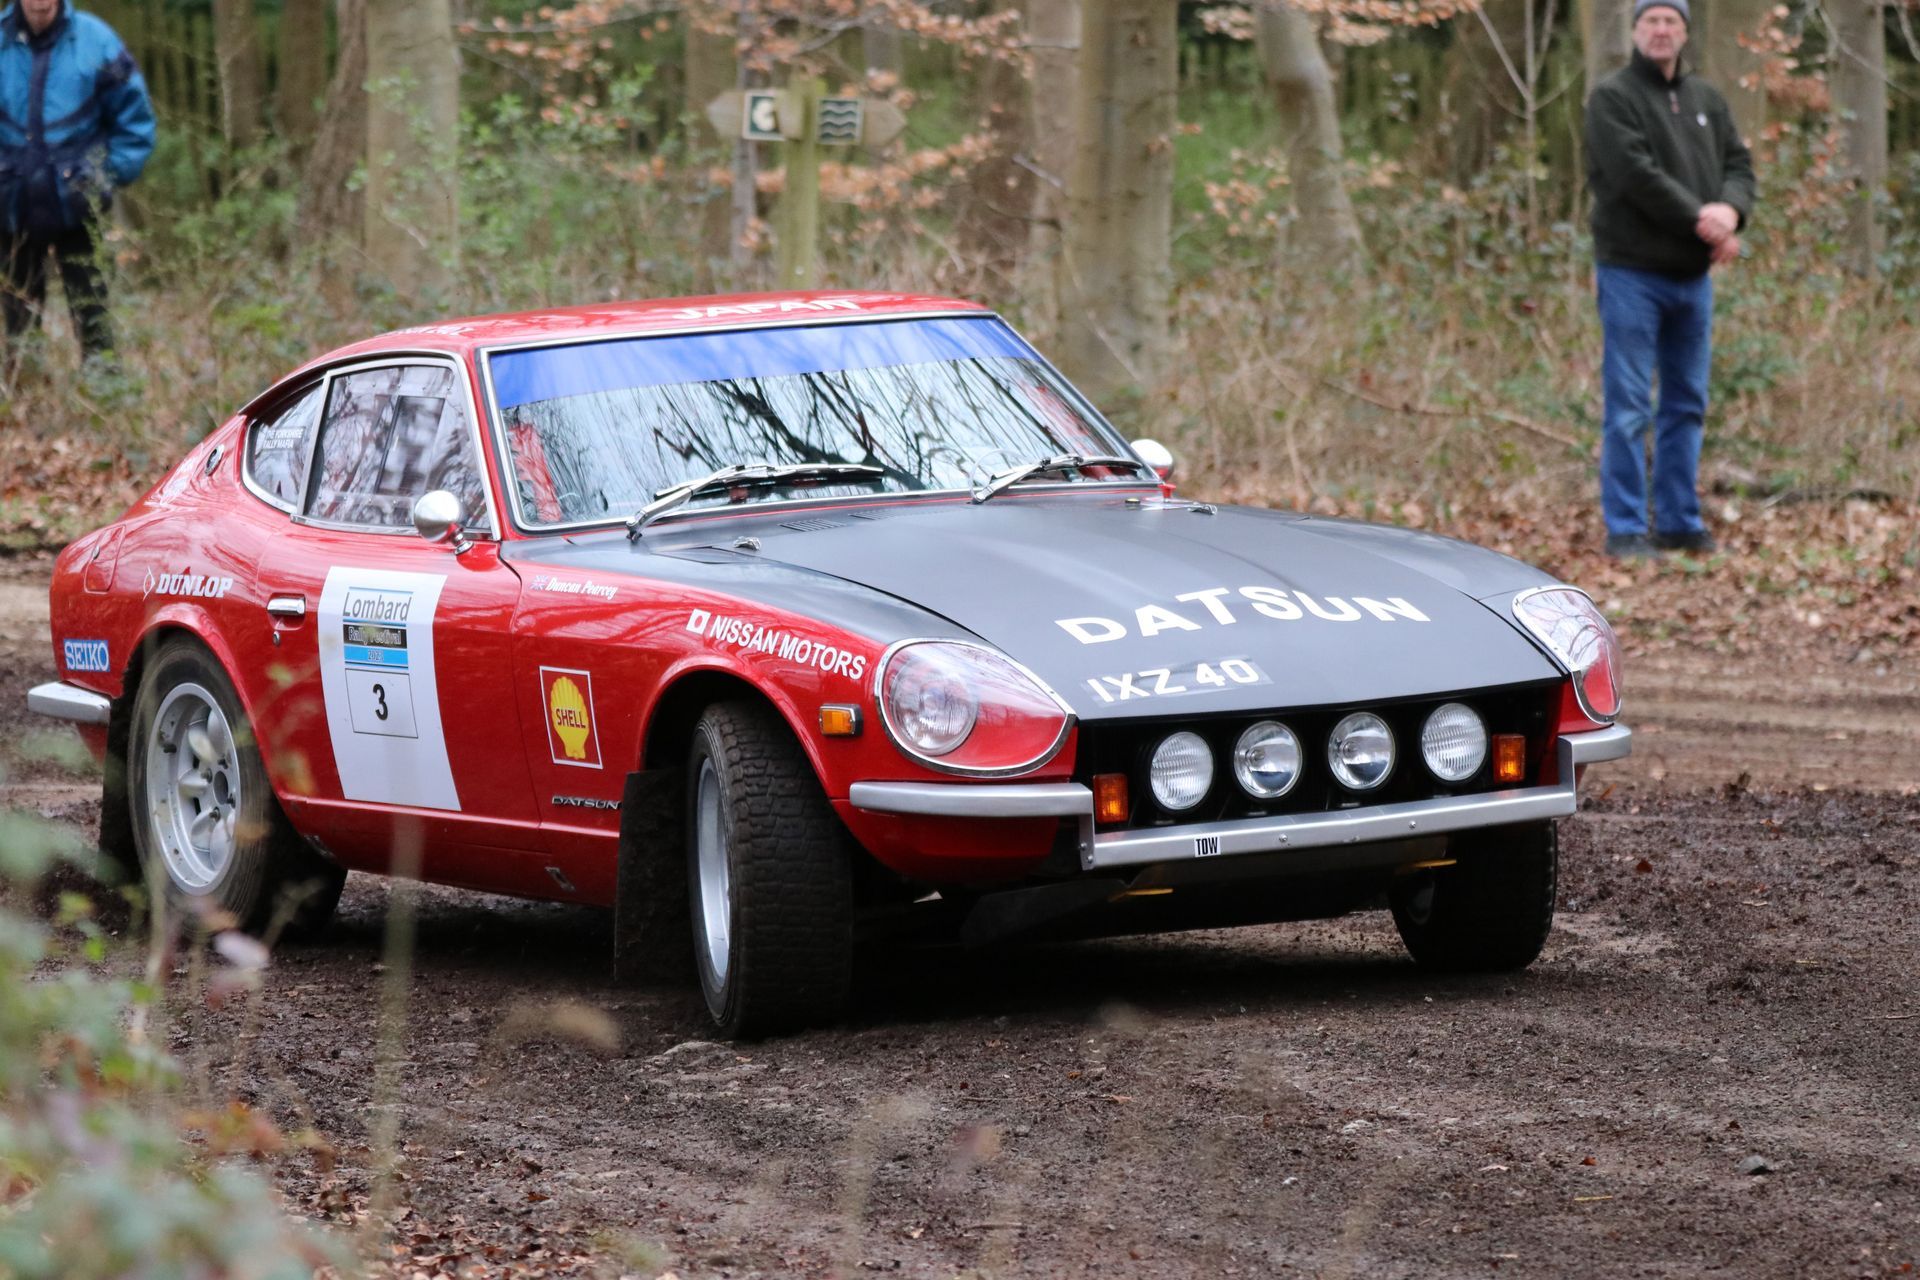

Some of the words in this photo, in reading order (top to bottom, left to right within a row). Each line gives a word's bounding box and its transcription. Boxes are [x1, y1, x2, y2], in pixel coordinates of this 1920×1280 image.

[156, 573, 233, 598] DUNLOP
[545, 577, 581, 593] Duncan
[342, 591, 412, 621] Lombard
[1055, 586, 1431, 644] DATSUN
[65, 641, 109, 671] SEIKO
[709, 615, 780, 655] NISSAN
[777, 634, 866, 680] MOTORS
[1195, 659, 1259, 687] 40
[372, 683, 389, 721] 3
[555, 708, 586, 729] SHELL
[551, 795, 620, 810] DATSUN
[1195, 836, 1218, 856] TOW
